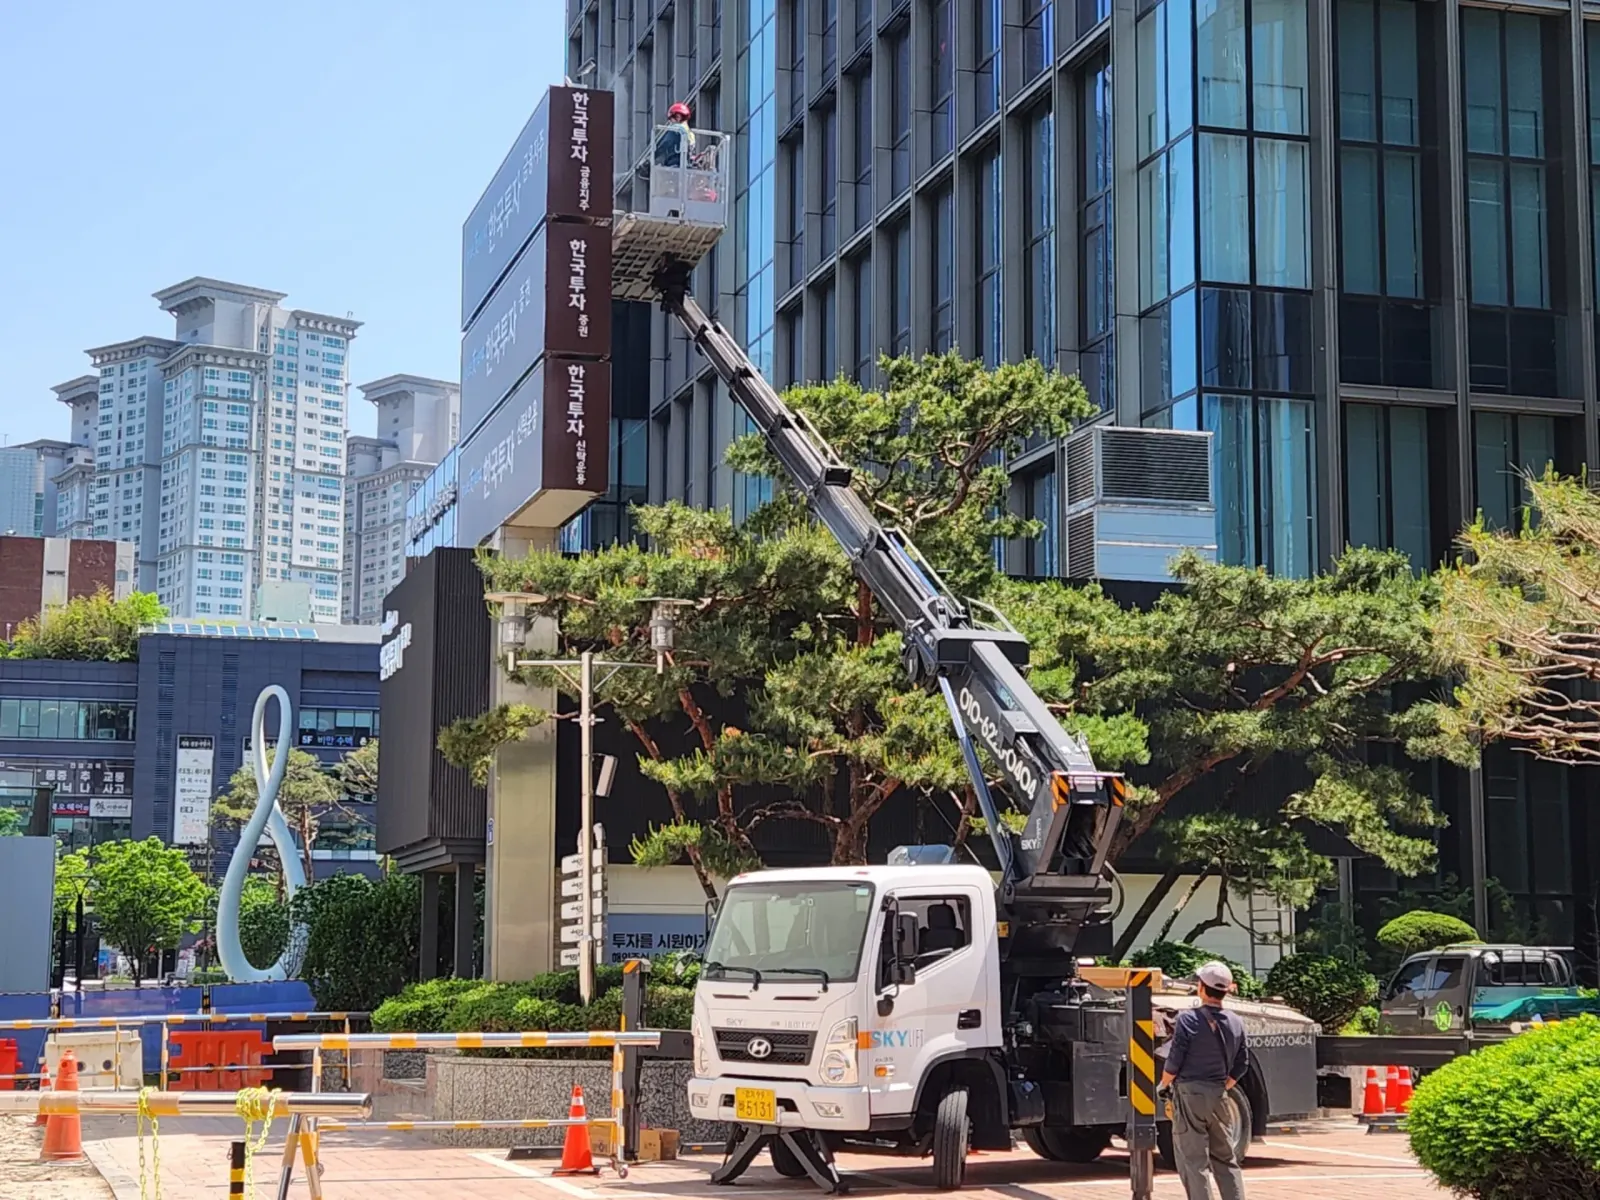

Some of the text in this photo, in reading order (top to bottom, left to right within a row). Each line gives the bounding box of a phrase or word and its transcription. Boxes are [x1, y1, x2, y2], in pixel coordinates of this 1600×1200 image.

[571, 92, 591, 211] 한국투자 금융지주
[488, 170, 522, 253] 한국투자
[568, 239, 589, 337] 한국투자 증권
[486, 301, 518, 376] 한국투자
[566, 364, 587, 485] 한국투자 신탁운용
[483, 430, 515, 500] 한국투자
[102, 783, 125, 794] 사고
[612, 933, 653, 949] 투자를
